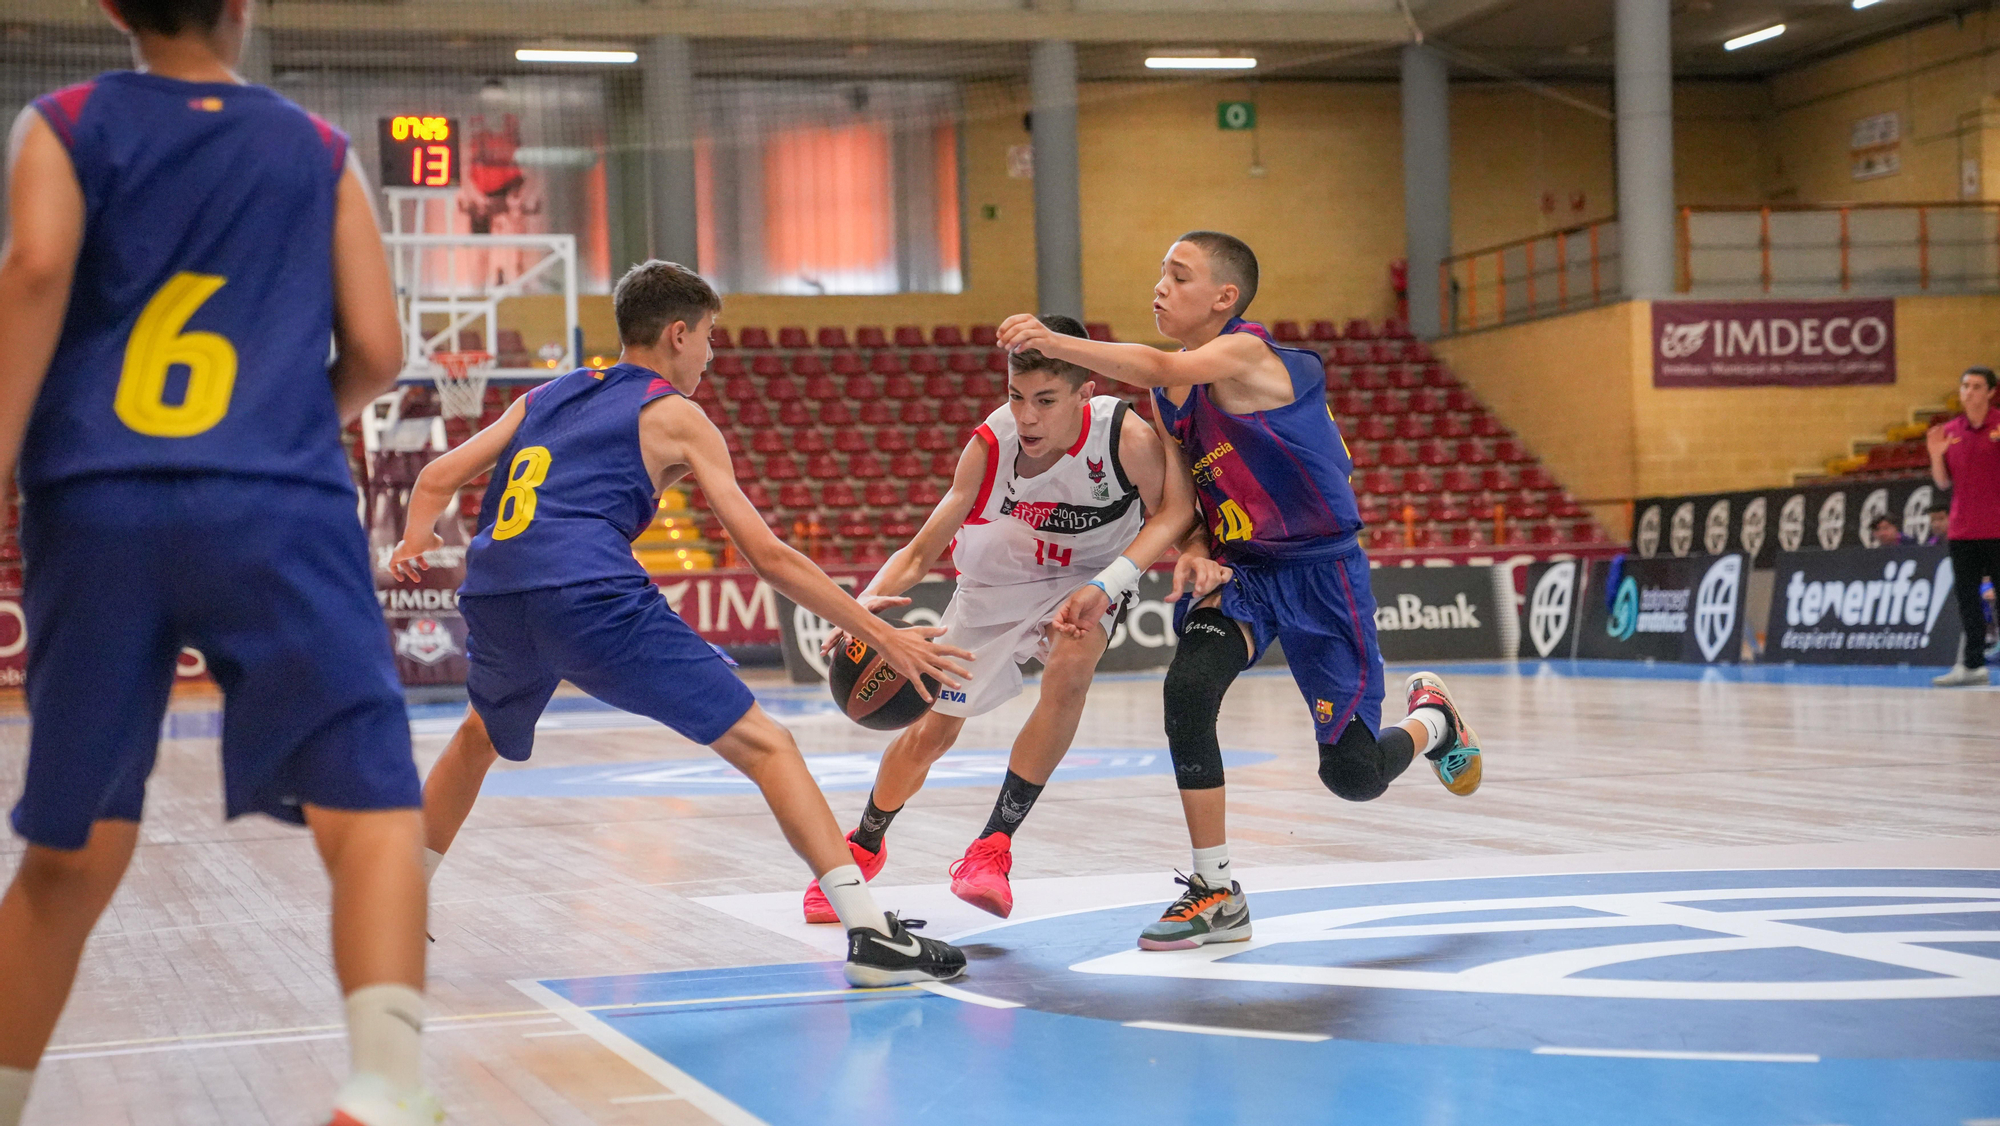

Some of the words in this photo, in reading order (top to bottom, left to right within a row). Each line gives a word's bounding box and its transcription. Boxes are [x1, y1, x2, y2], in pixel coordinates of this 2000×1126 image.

[412, 145, 450, 186] 13
[113, 271, 238, 437] 6
[1712, 316, 1888, 357] IMDECO
[491, 445, 553, 541] 8
[1033, 537, 1072, 567] 14
[390, 588, 460, 611] IMDE
[937, 689, 967, 704] EVA
